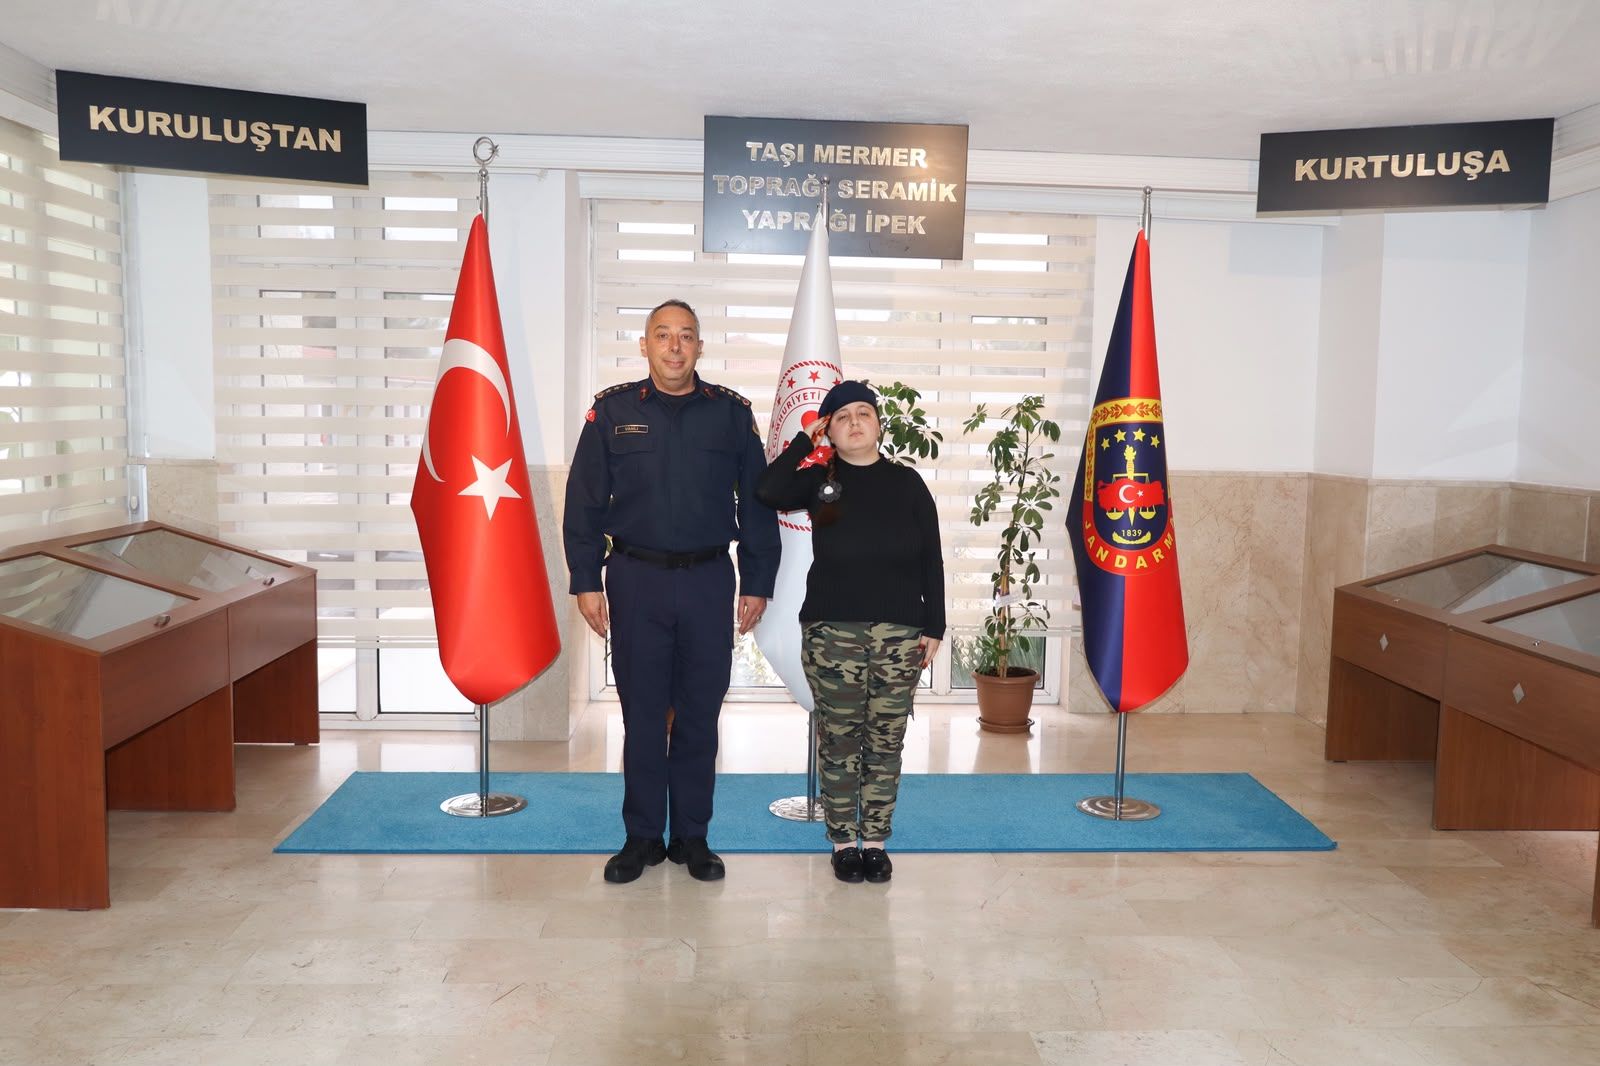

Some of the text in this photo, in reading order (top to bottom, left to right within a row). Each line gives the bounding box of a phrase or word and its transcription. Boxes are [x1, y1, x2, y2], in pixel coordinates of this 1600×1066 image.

[89, 105, 342, 152] KURULUŞTAN
[746, 141, 928, 168] TAŞI MERMER
[1294, 149, 1511, 181] KURTULUŞA
[712, 174, 958, 203] TOPRAĞ SERAMİK
[742, 209, 927, 235] YAPRĞI İPEK
[1121, 529, 1142, 537] 1839
